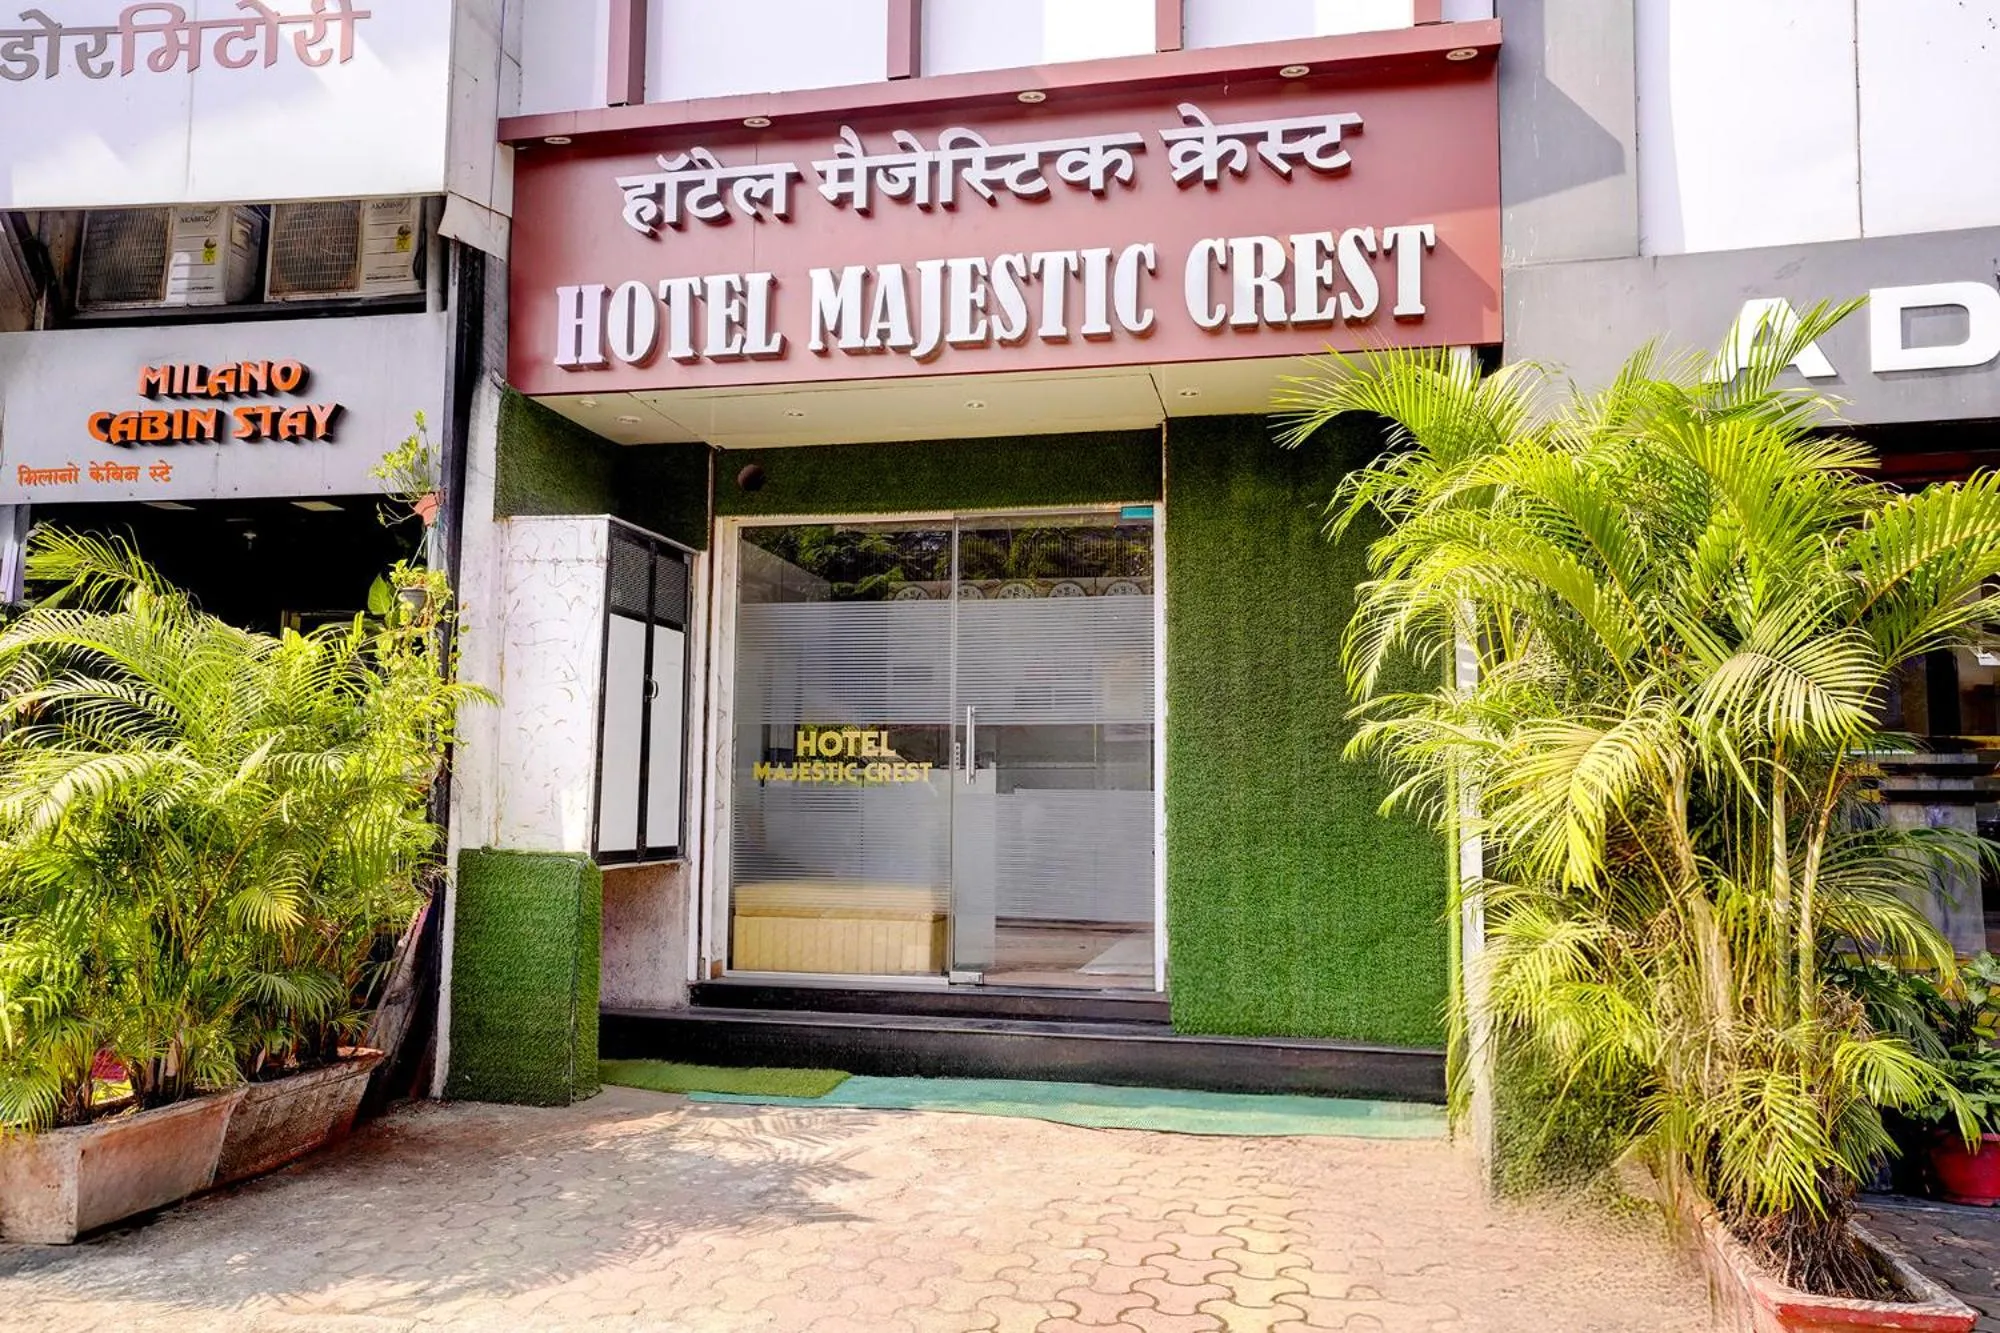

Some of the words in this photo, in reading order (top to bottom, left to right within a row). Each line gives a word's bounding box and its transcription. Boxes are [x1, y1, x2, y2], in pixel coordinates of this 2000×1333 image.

[615, 147, 801, 236] हॉटेल
[811, 125, 1146, 212] मैजेस्टिक
[1159, 103, 1364, 187] क्रेस्ट
[554, 272, 787, 370] HOTEL
[808, 243, 1157, 361] MAJESTIC
[1184, 223, 1436, 332] CREST
[139, 359, 306, 397] MILANO
[88, 407, 220, 445] CABIN
[233, 402, 340, 442] STAY
[149, 459, 173, 482] स्टे
[796, 730, 897, 757] HOTEL
[753, 760, 859, 784] MAJESTIC
[863, 761, 932, 784] CREST
